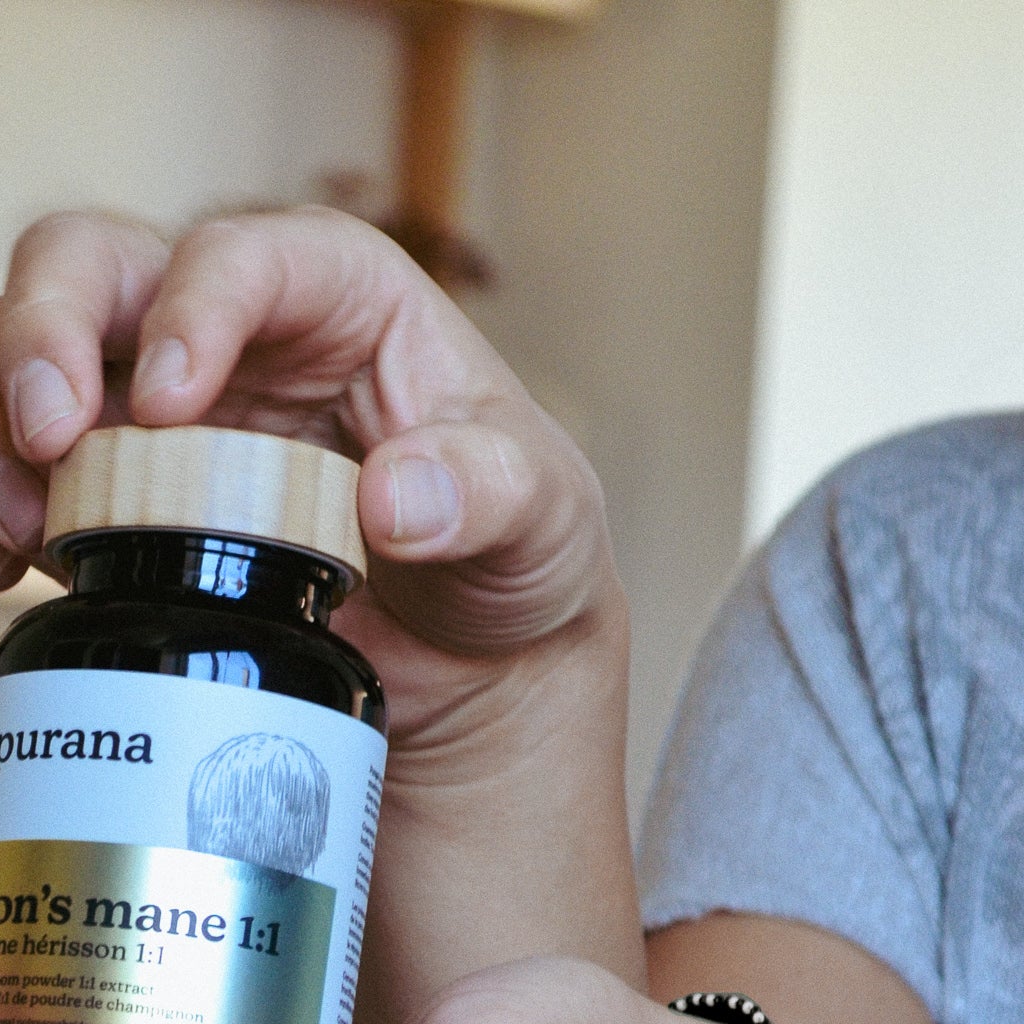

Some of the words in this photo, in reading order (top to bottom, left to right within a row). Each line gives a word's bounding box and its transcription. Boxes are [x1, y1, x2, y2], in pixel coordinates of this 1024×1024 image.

[83, 897, 227, 942] mane
[237, 916, 281, 956] 1:1
[20, 933, 127, 962] hérisson
[136, 944, 165, 964] 1:1
[21, 973, 75, 989] powder
[79, 975, 95, 990] 1:1
[99, 980, 154, 995] extract
[12, 991, 27, 1005] de
[29, 993, 82, 1008] poudre
[85, 996, 103, 1010] de
[106, 999, 204, 1023] champignon
